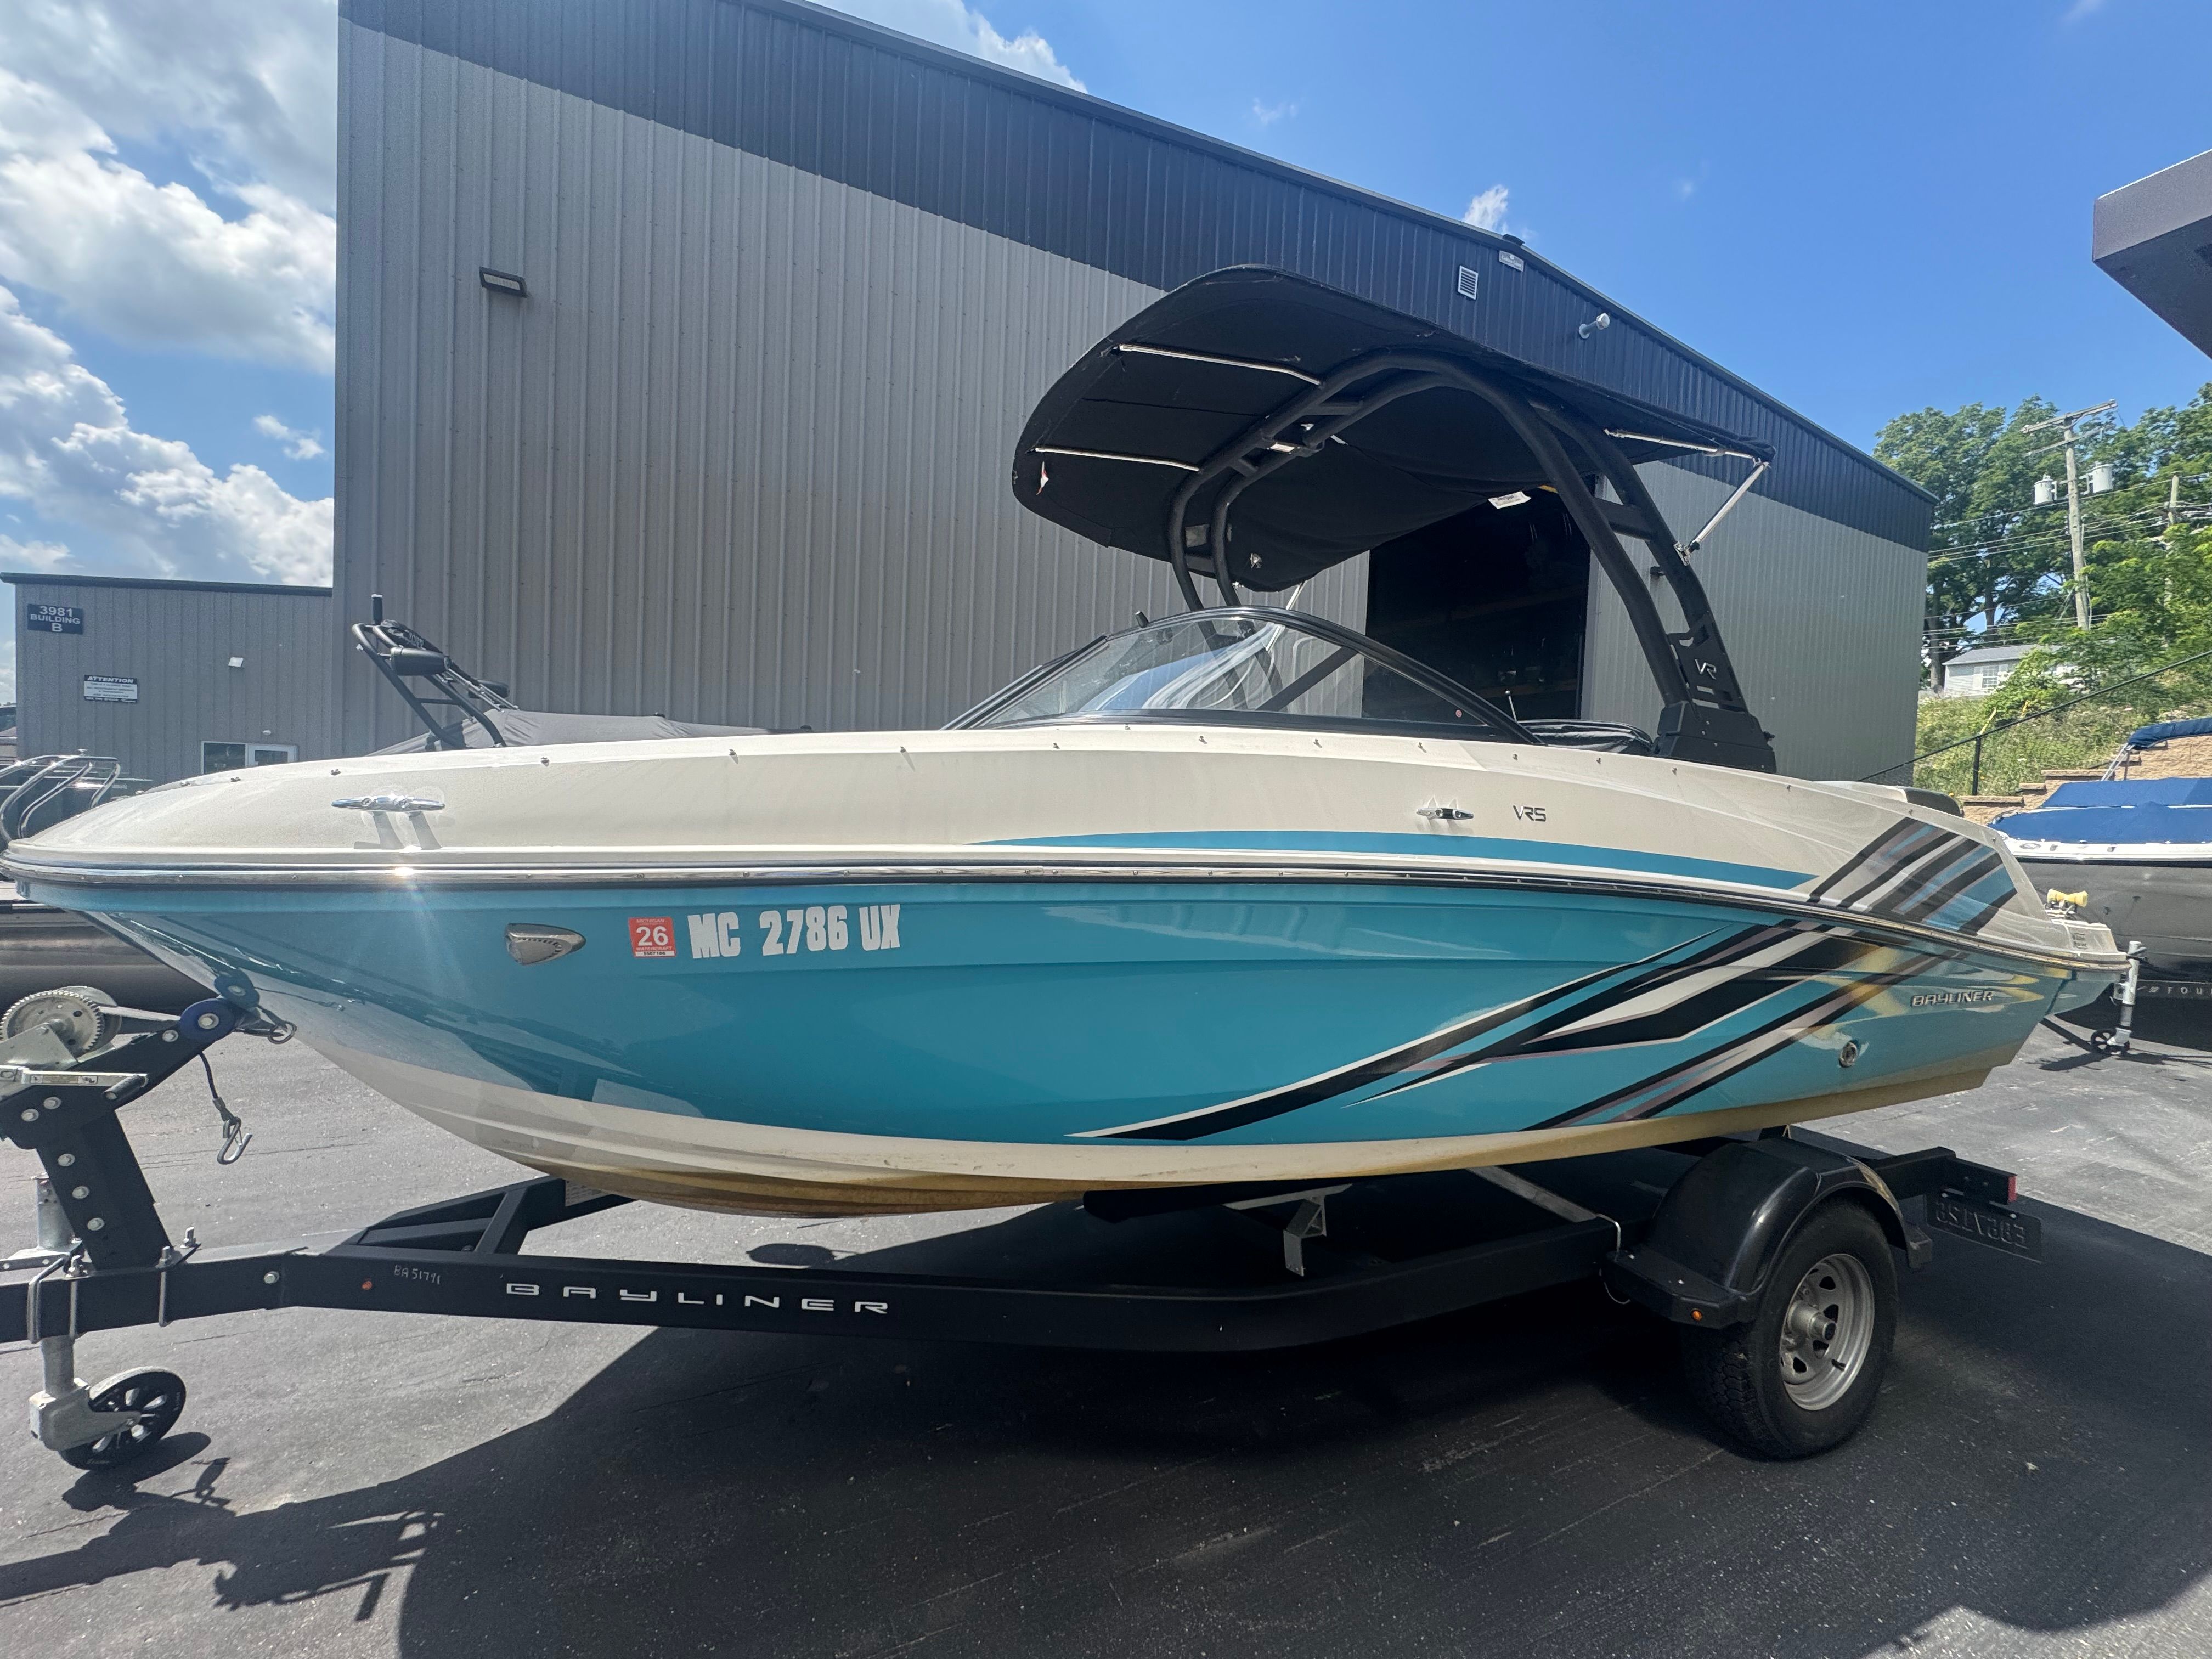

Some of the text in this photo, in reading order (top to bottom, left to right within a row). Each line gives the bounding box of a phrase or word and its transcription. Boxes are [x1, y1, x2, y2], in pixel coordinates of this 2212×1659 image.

[30, 613, 80, 624] BUILDING
[40, 606, 72, 617] 3981
[52, 623, 63, 632] B
[1513, 805, 1546, 822] VRS
[636, 926, 668, 946] 26
[687, 904, 900, 959] MC 2786 UX
[1911, 991, 1994, 1007] BAYLINER
[506, 1283, 888, 1314] BAYLINER
